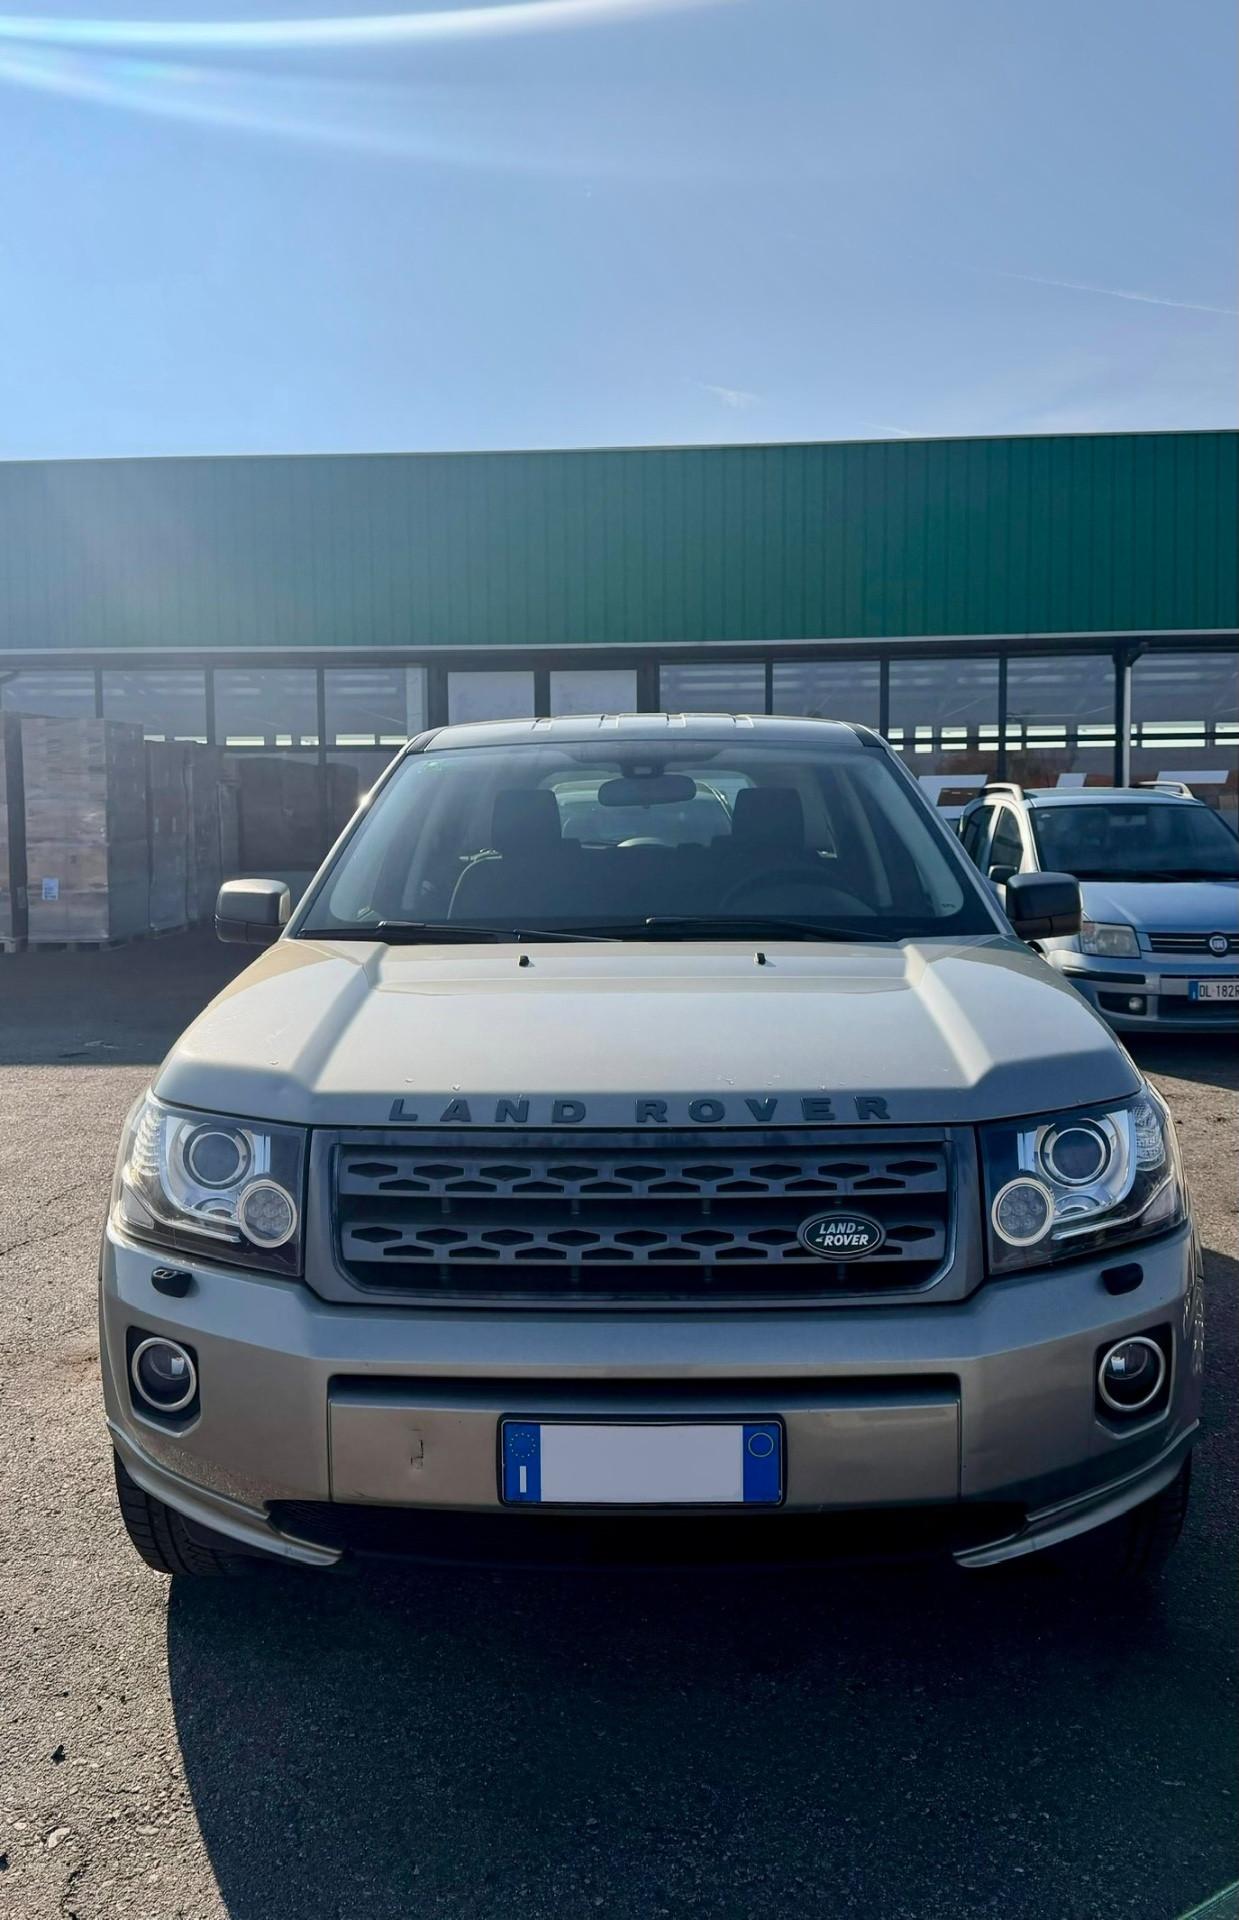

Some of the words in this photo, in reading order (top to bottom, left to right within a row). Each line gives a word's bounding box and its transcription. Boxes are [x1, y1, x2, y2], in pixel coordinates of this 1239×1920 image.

[388, 1098, 587, 1123] LAND
[635, 1096, 891, 1123] ROVER
[820, 1222, 856, 1234] LAND
[823, 1234, 869, 1246] ROVER
